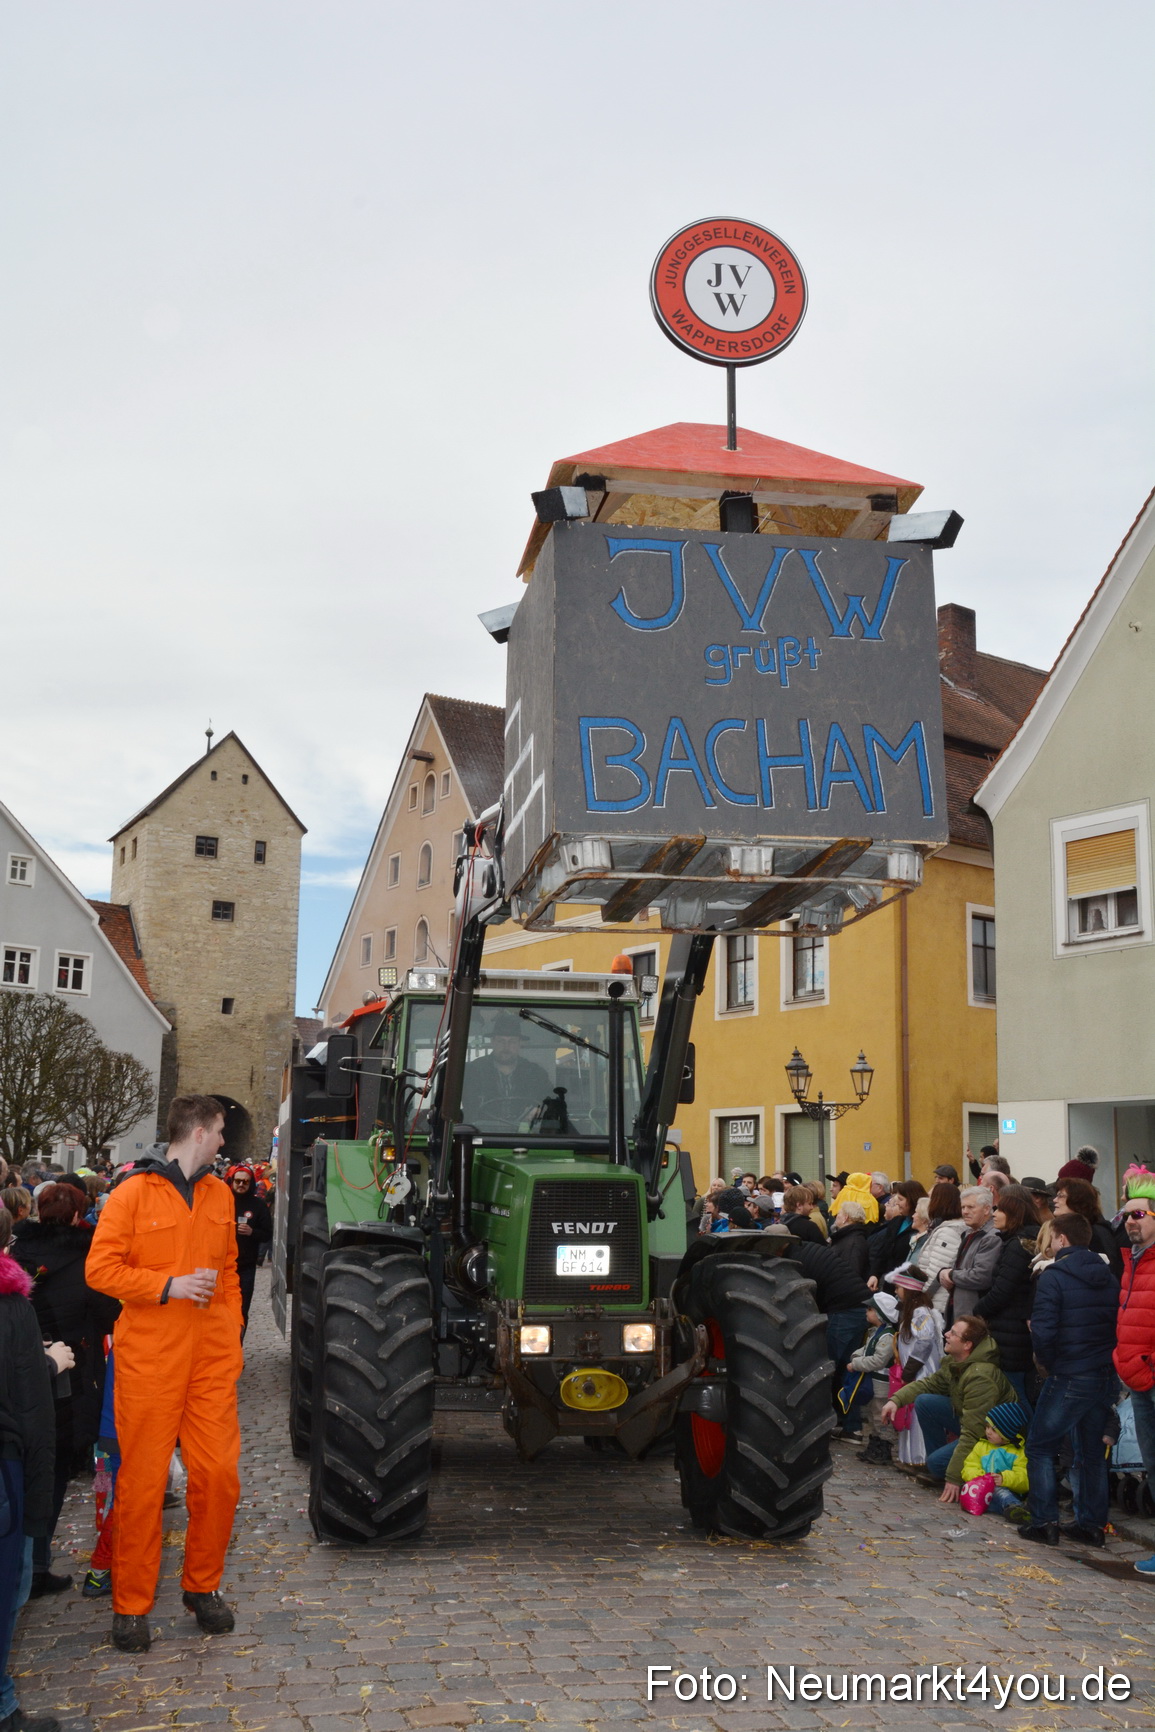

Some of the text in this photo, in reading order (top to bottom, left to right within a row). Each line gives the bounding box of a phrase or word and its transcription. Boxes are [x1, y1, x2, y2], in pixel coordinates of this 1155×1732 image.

[665, 227, 796, 294] JUNGGESELLENVEREIN
[706, 262, 753, 289] JV
[712, 292, 748, 317] W
[672, 308, 790, 353] WAPPERSDORF
[602, 534, 910, 641] JVW
[704, 635, 822, 688] grüßt
[578, 715, 934, 819] BACHAM
[730, 1121, 753, 1135] BW
[551, 1222, 618, 1234] FENDT
[562, 1261, 603, 1273] GF 614
[570, 1249, 586, 1260] NM
